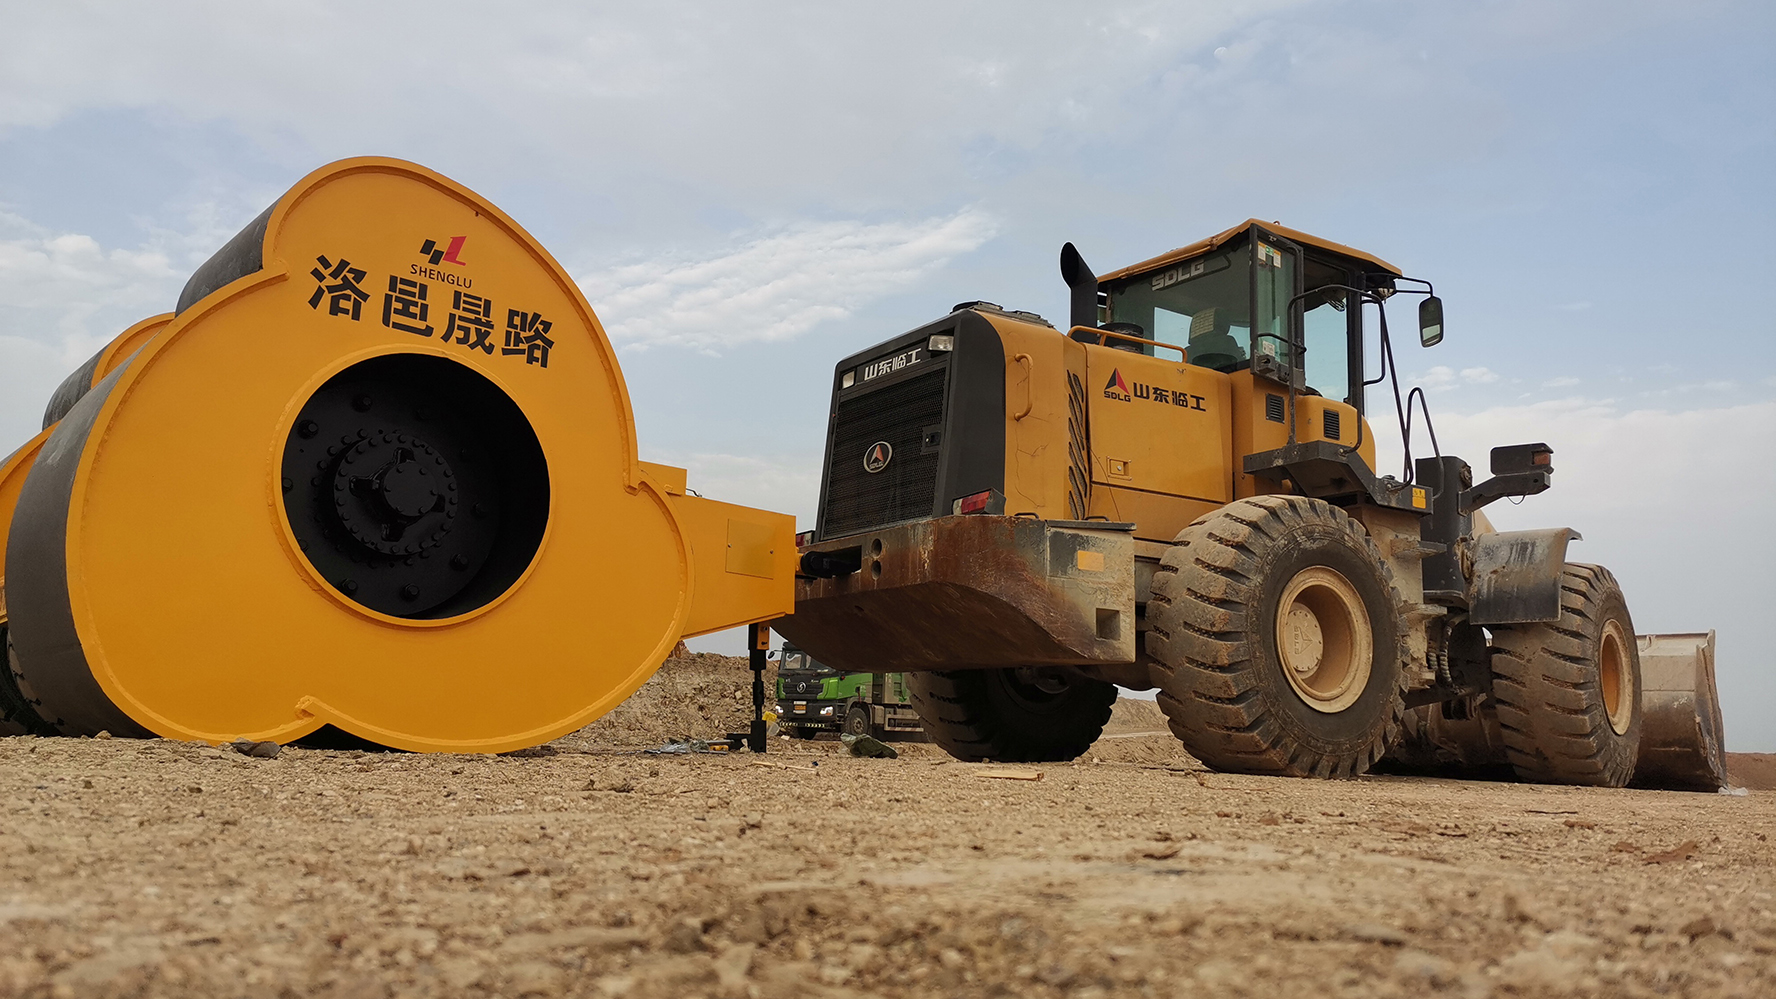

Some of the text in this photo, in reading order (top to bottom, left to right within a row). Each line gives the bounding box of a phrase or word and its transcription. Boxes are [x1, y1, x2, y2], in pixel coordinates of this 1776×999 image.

[410, 263, 473, 289] SHENGLU
[1151, 259, 1205, 291] SDLG
[308, 254, 555, 369] 洛邑晟路
[864, 348, 922, 381] 山东临工
[1103, 390, 1131, 403] SDLG
[1133, 382, 1207, 412] 山东临工
